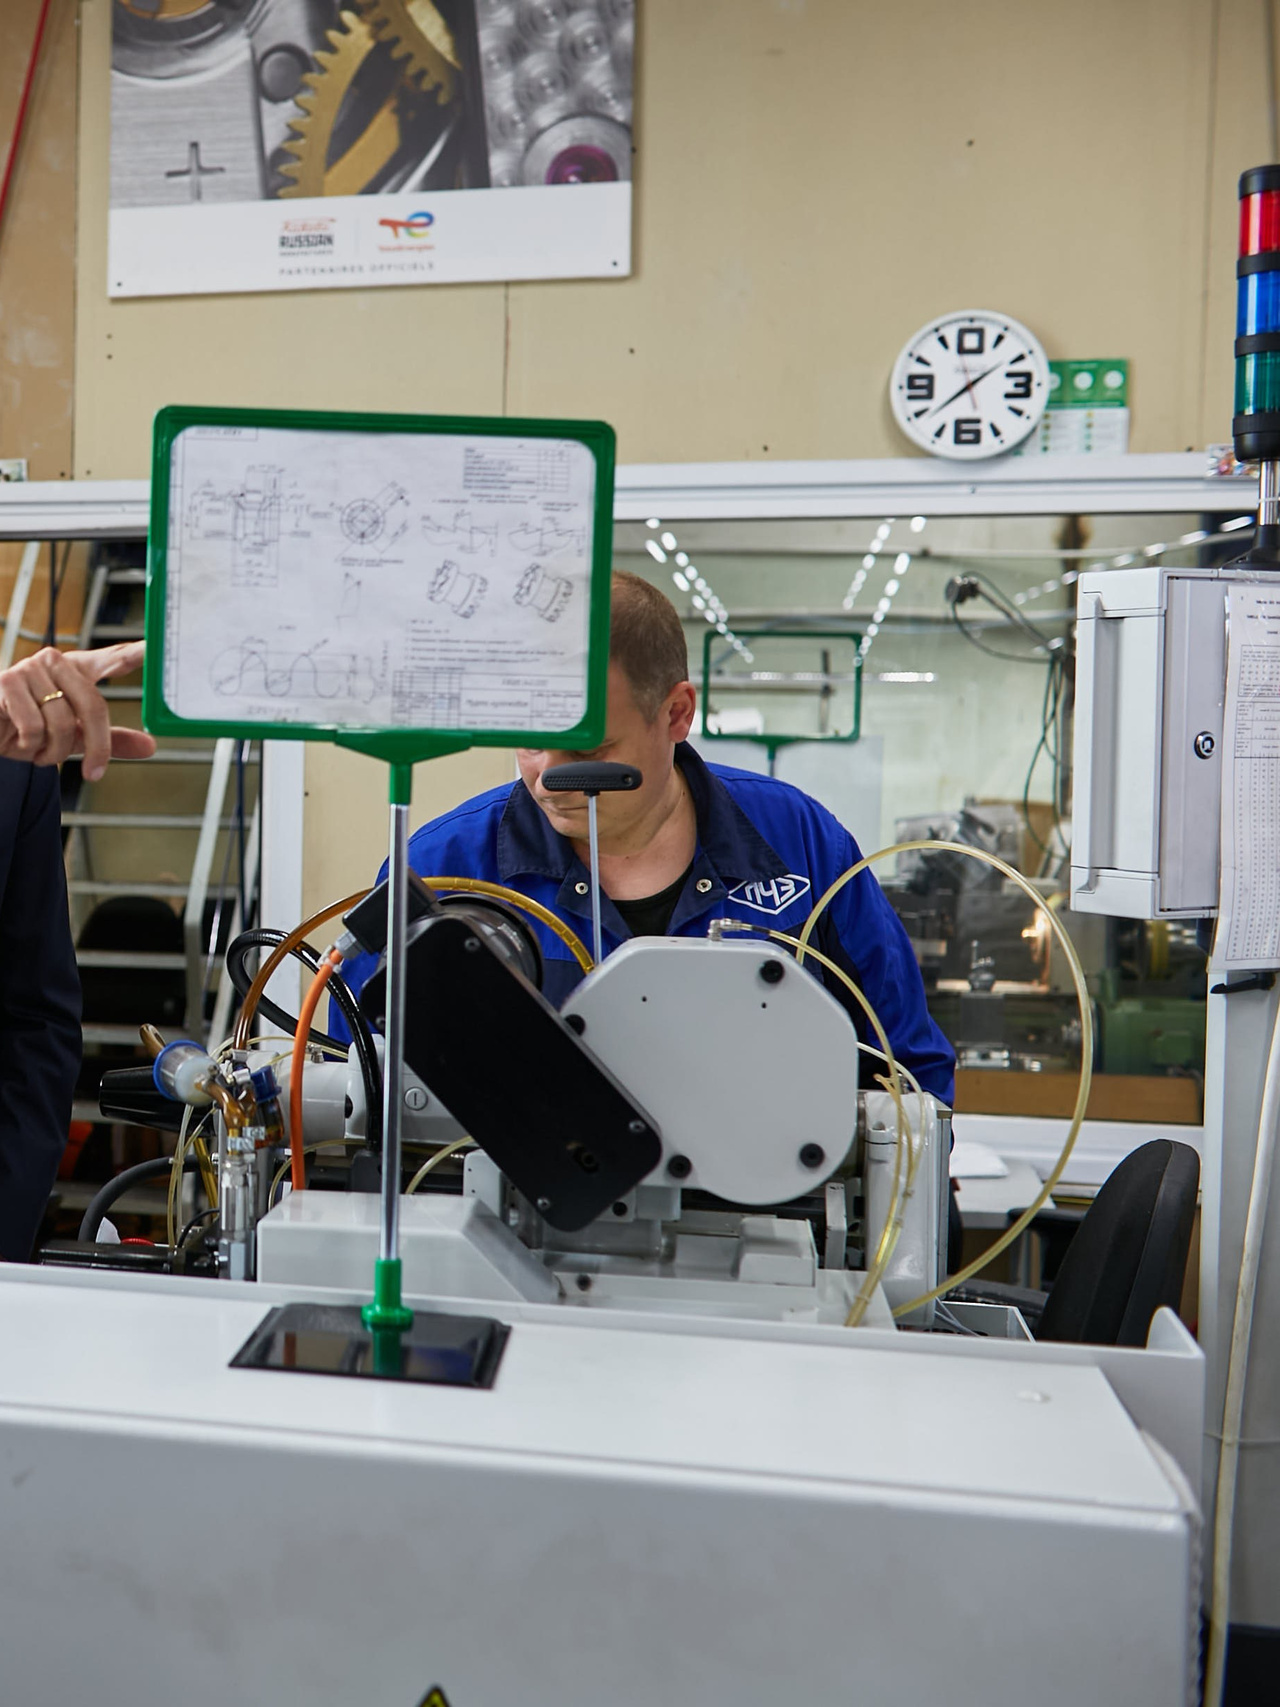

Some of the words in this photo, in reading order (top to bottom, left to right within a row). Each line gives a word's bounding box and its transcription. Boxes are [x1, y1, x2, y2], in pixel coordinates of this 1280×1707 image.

[906, 374, 935, 400] 9
[1003, 371, 1033, 399] 3
[953, 418, 982, 445] 6
